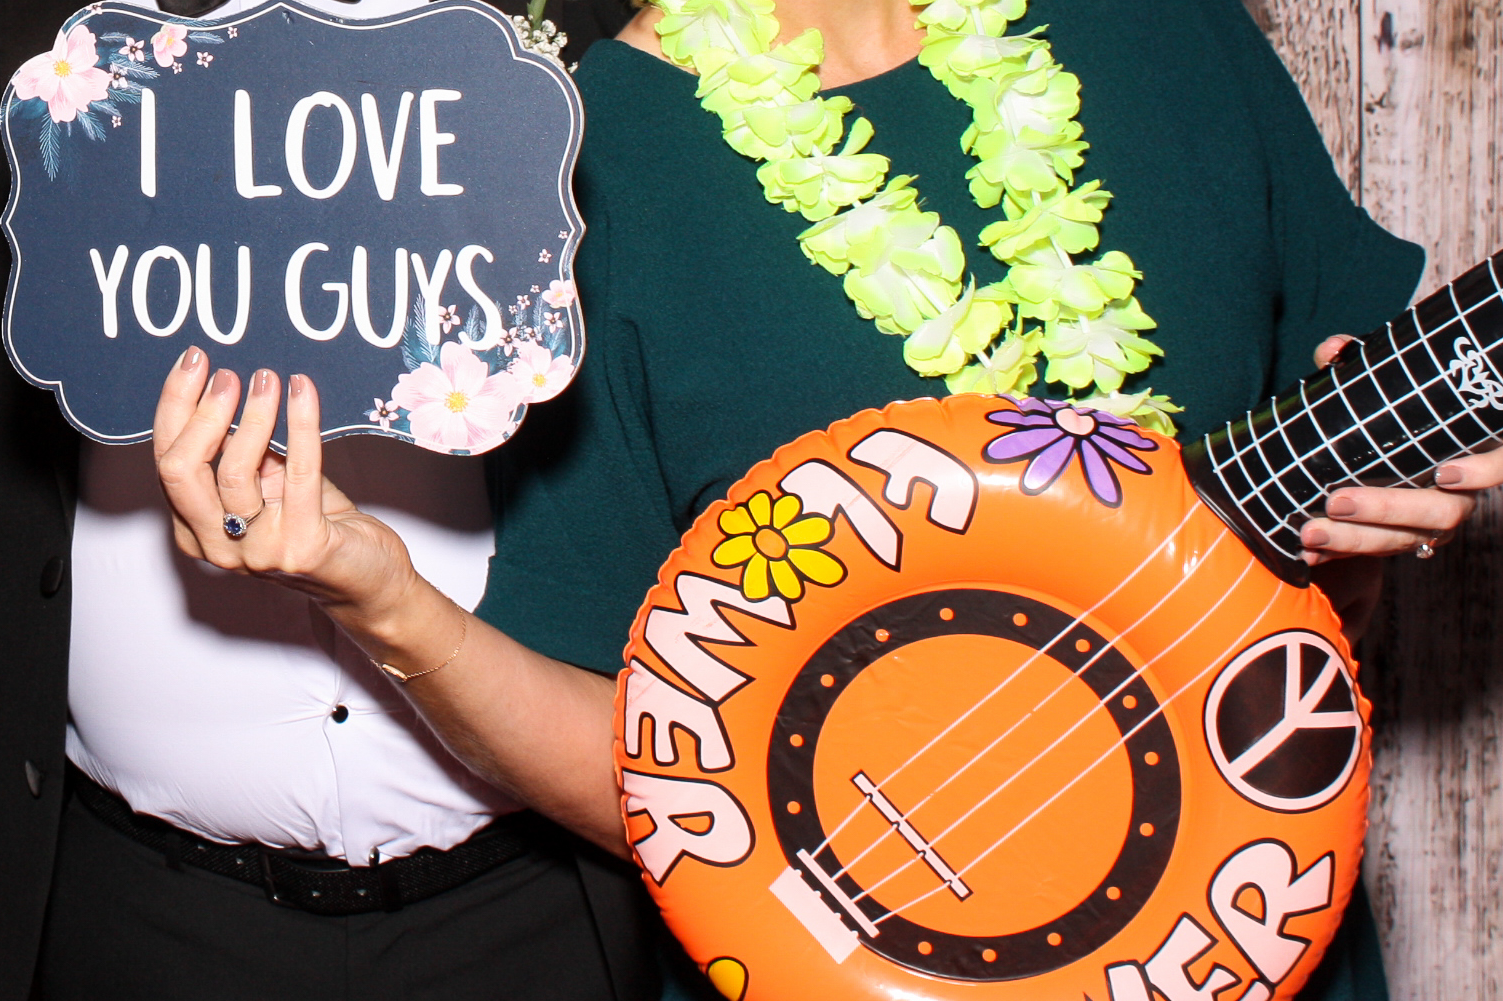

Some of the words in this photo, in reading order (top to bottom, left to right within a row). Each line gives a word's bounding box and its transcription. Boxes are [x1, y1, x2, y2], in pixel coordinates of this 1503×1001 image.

[140, 88, 156, 198] I
[234, 88, 465, 200] LOVE
[89, 243, 251, 345] YOU
[284, 242, 500, 351] GUYS
